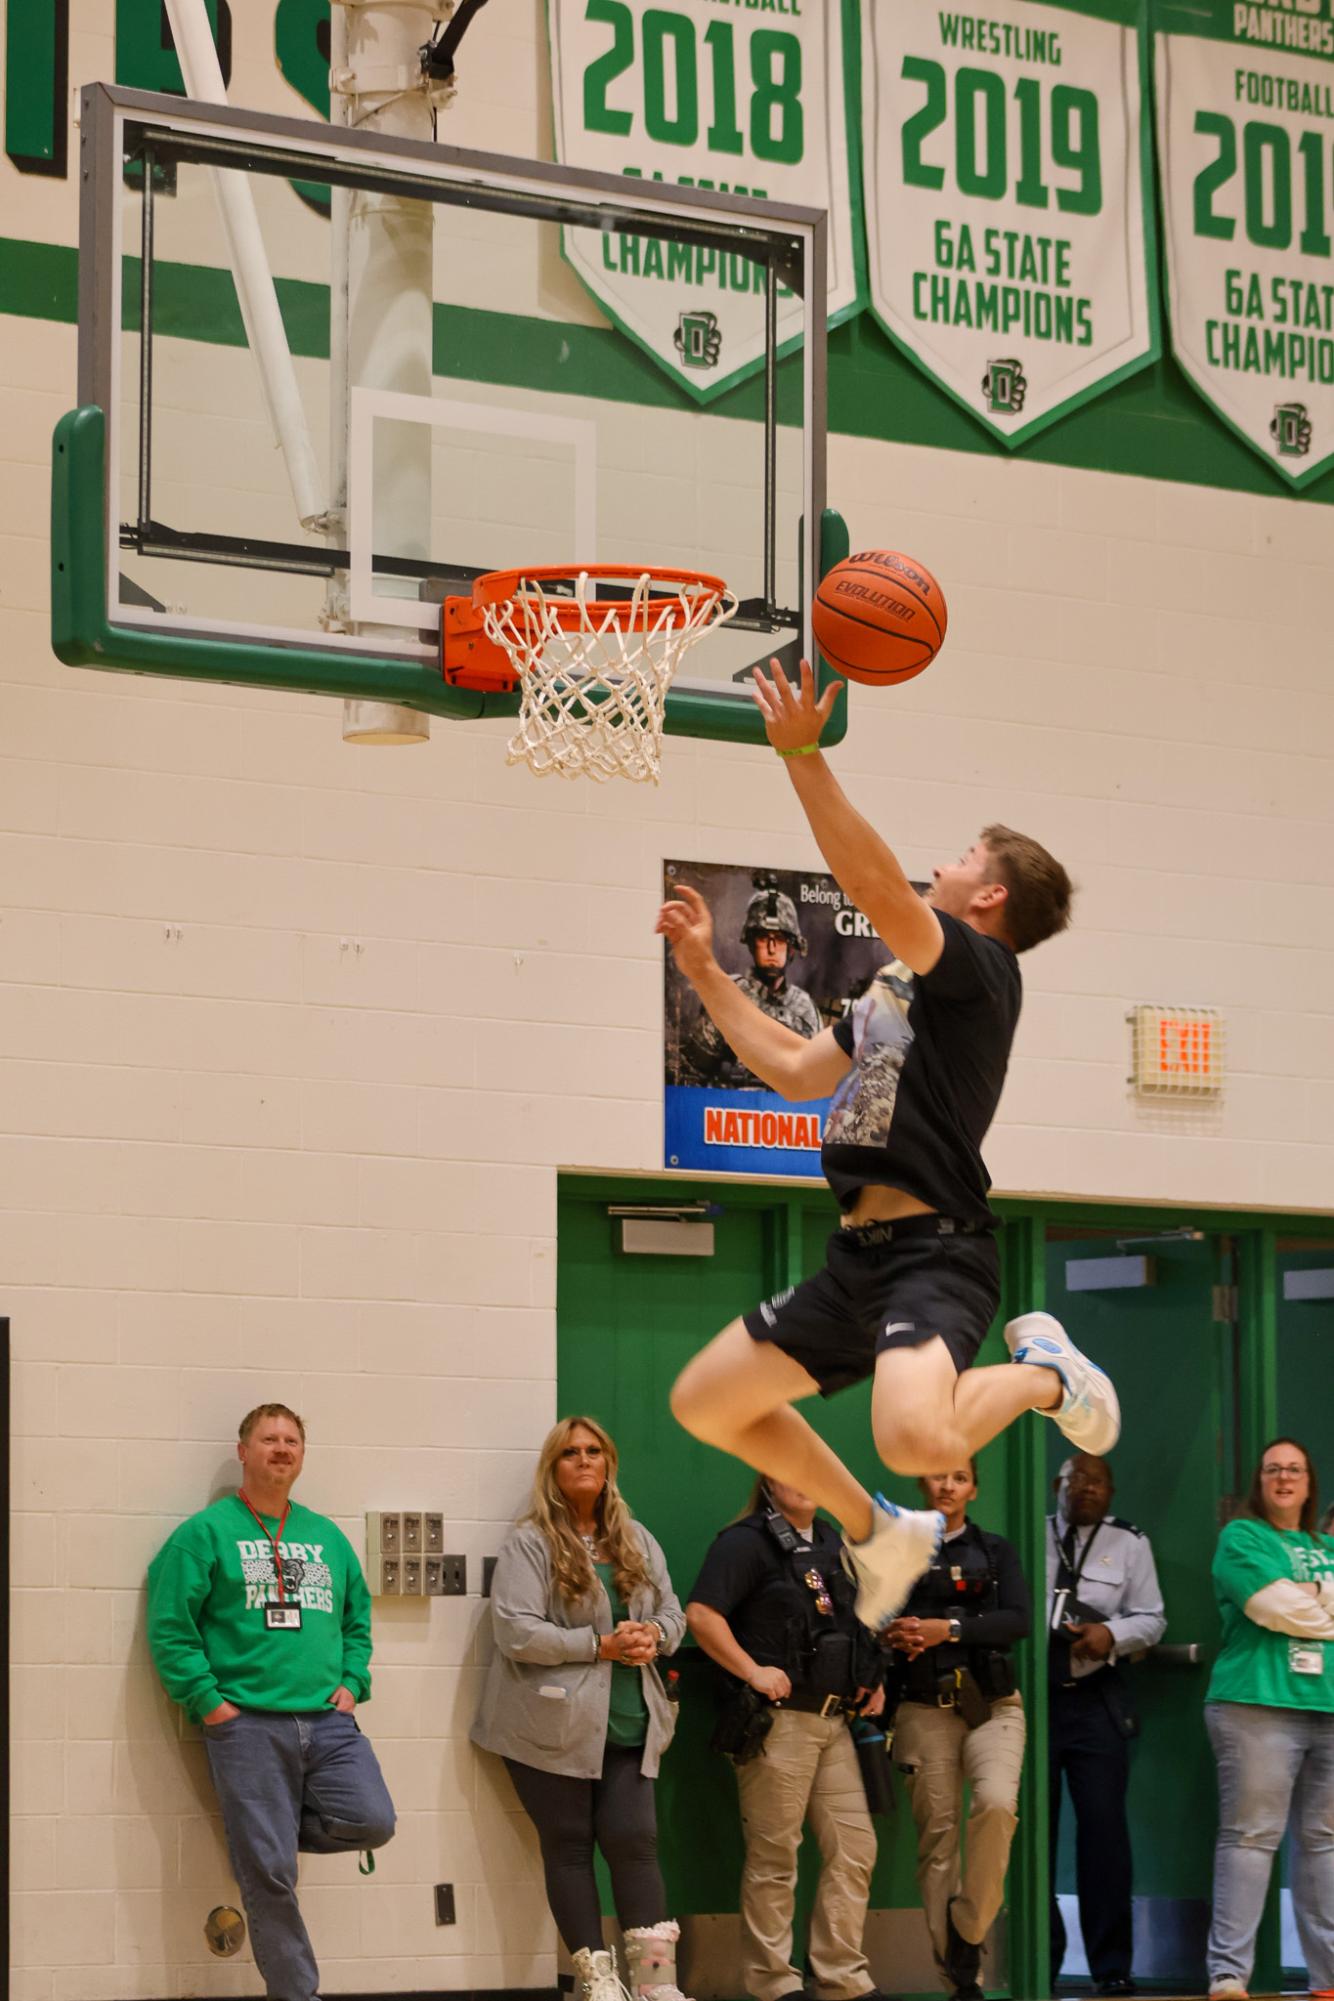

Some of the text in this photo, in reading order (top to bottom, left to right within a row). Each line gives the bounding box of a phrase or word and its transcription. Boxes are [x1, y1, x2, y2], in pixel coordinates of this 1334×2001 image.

[938, 11, 1062, 66] WRESTLING
[1234, 3, 1334, 54] PANTHERS
[583, 0, 805, 166] 2018
[1235, 69, 1334, 118] FOOTBALL
[901, 55, 1103, 217] 2019
[1193, 110, 1334, 259] 201
[602, 230, 794, 298] CHAMPION
[934, 220, 1072, 288] 6A STATE
[912, 271, 1093, 347] CHAMPIONS
[1225, 269, 1264, 320] 6A
[835, 580, 916, 621] EVOLUTION
[800, 884, 842, 911] Belong
[705, 1107, 823, 1149] NATIONAL
[236, 1540, 324, 1563] DERBY
